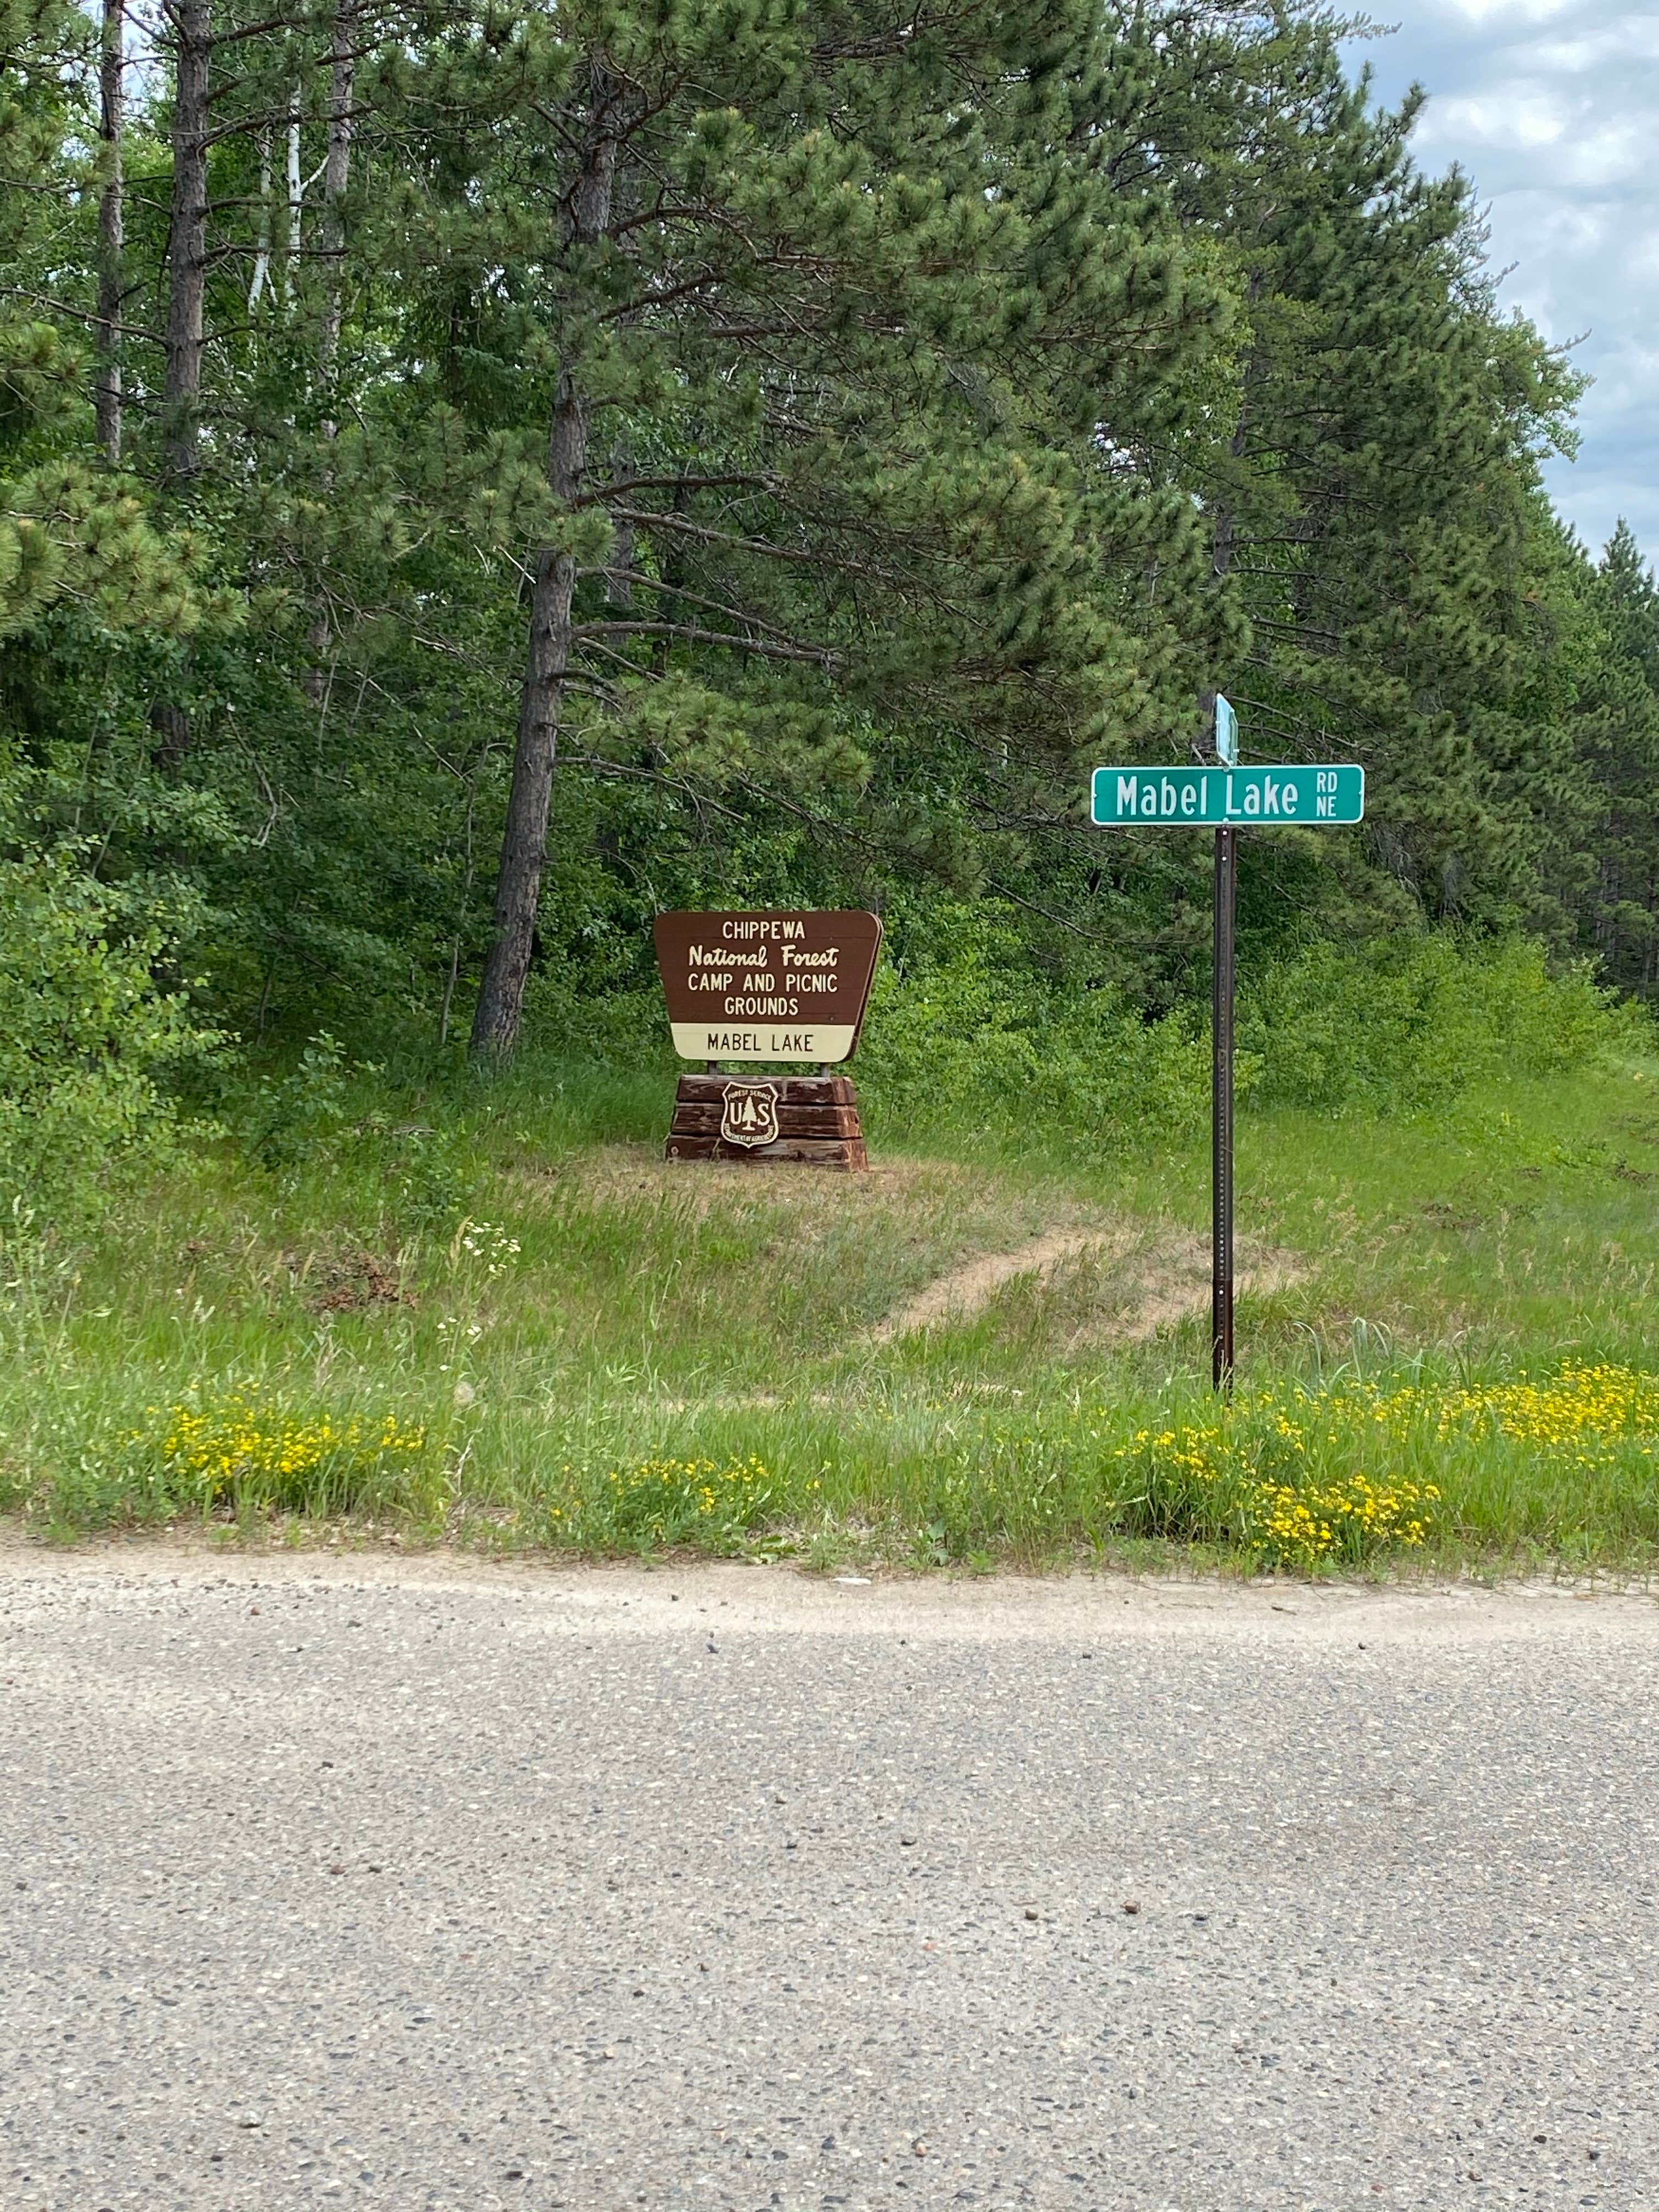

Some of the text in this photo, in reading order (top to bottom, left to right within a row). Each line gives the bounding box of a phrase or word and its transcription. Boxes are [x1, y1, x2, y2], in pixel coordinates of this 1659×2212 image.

[1316, 771, 1338, 793] RD
[1116, 775, 1299, 816] Mabel Lake
[1316, 796, 1337, 817] NE
[722, 921, 805, 939] CHIPPEWA
[689, 944, 840, 968] National Forest
[688, 973, 838, 992] CAMP AND PICNIC
[724, 997, 798, 1016] GROUNDS
[707, 1033, 814, 1052] MABEL LAKE
